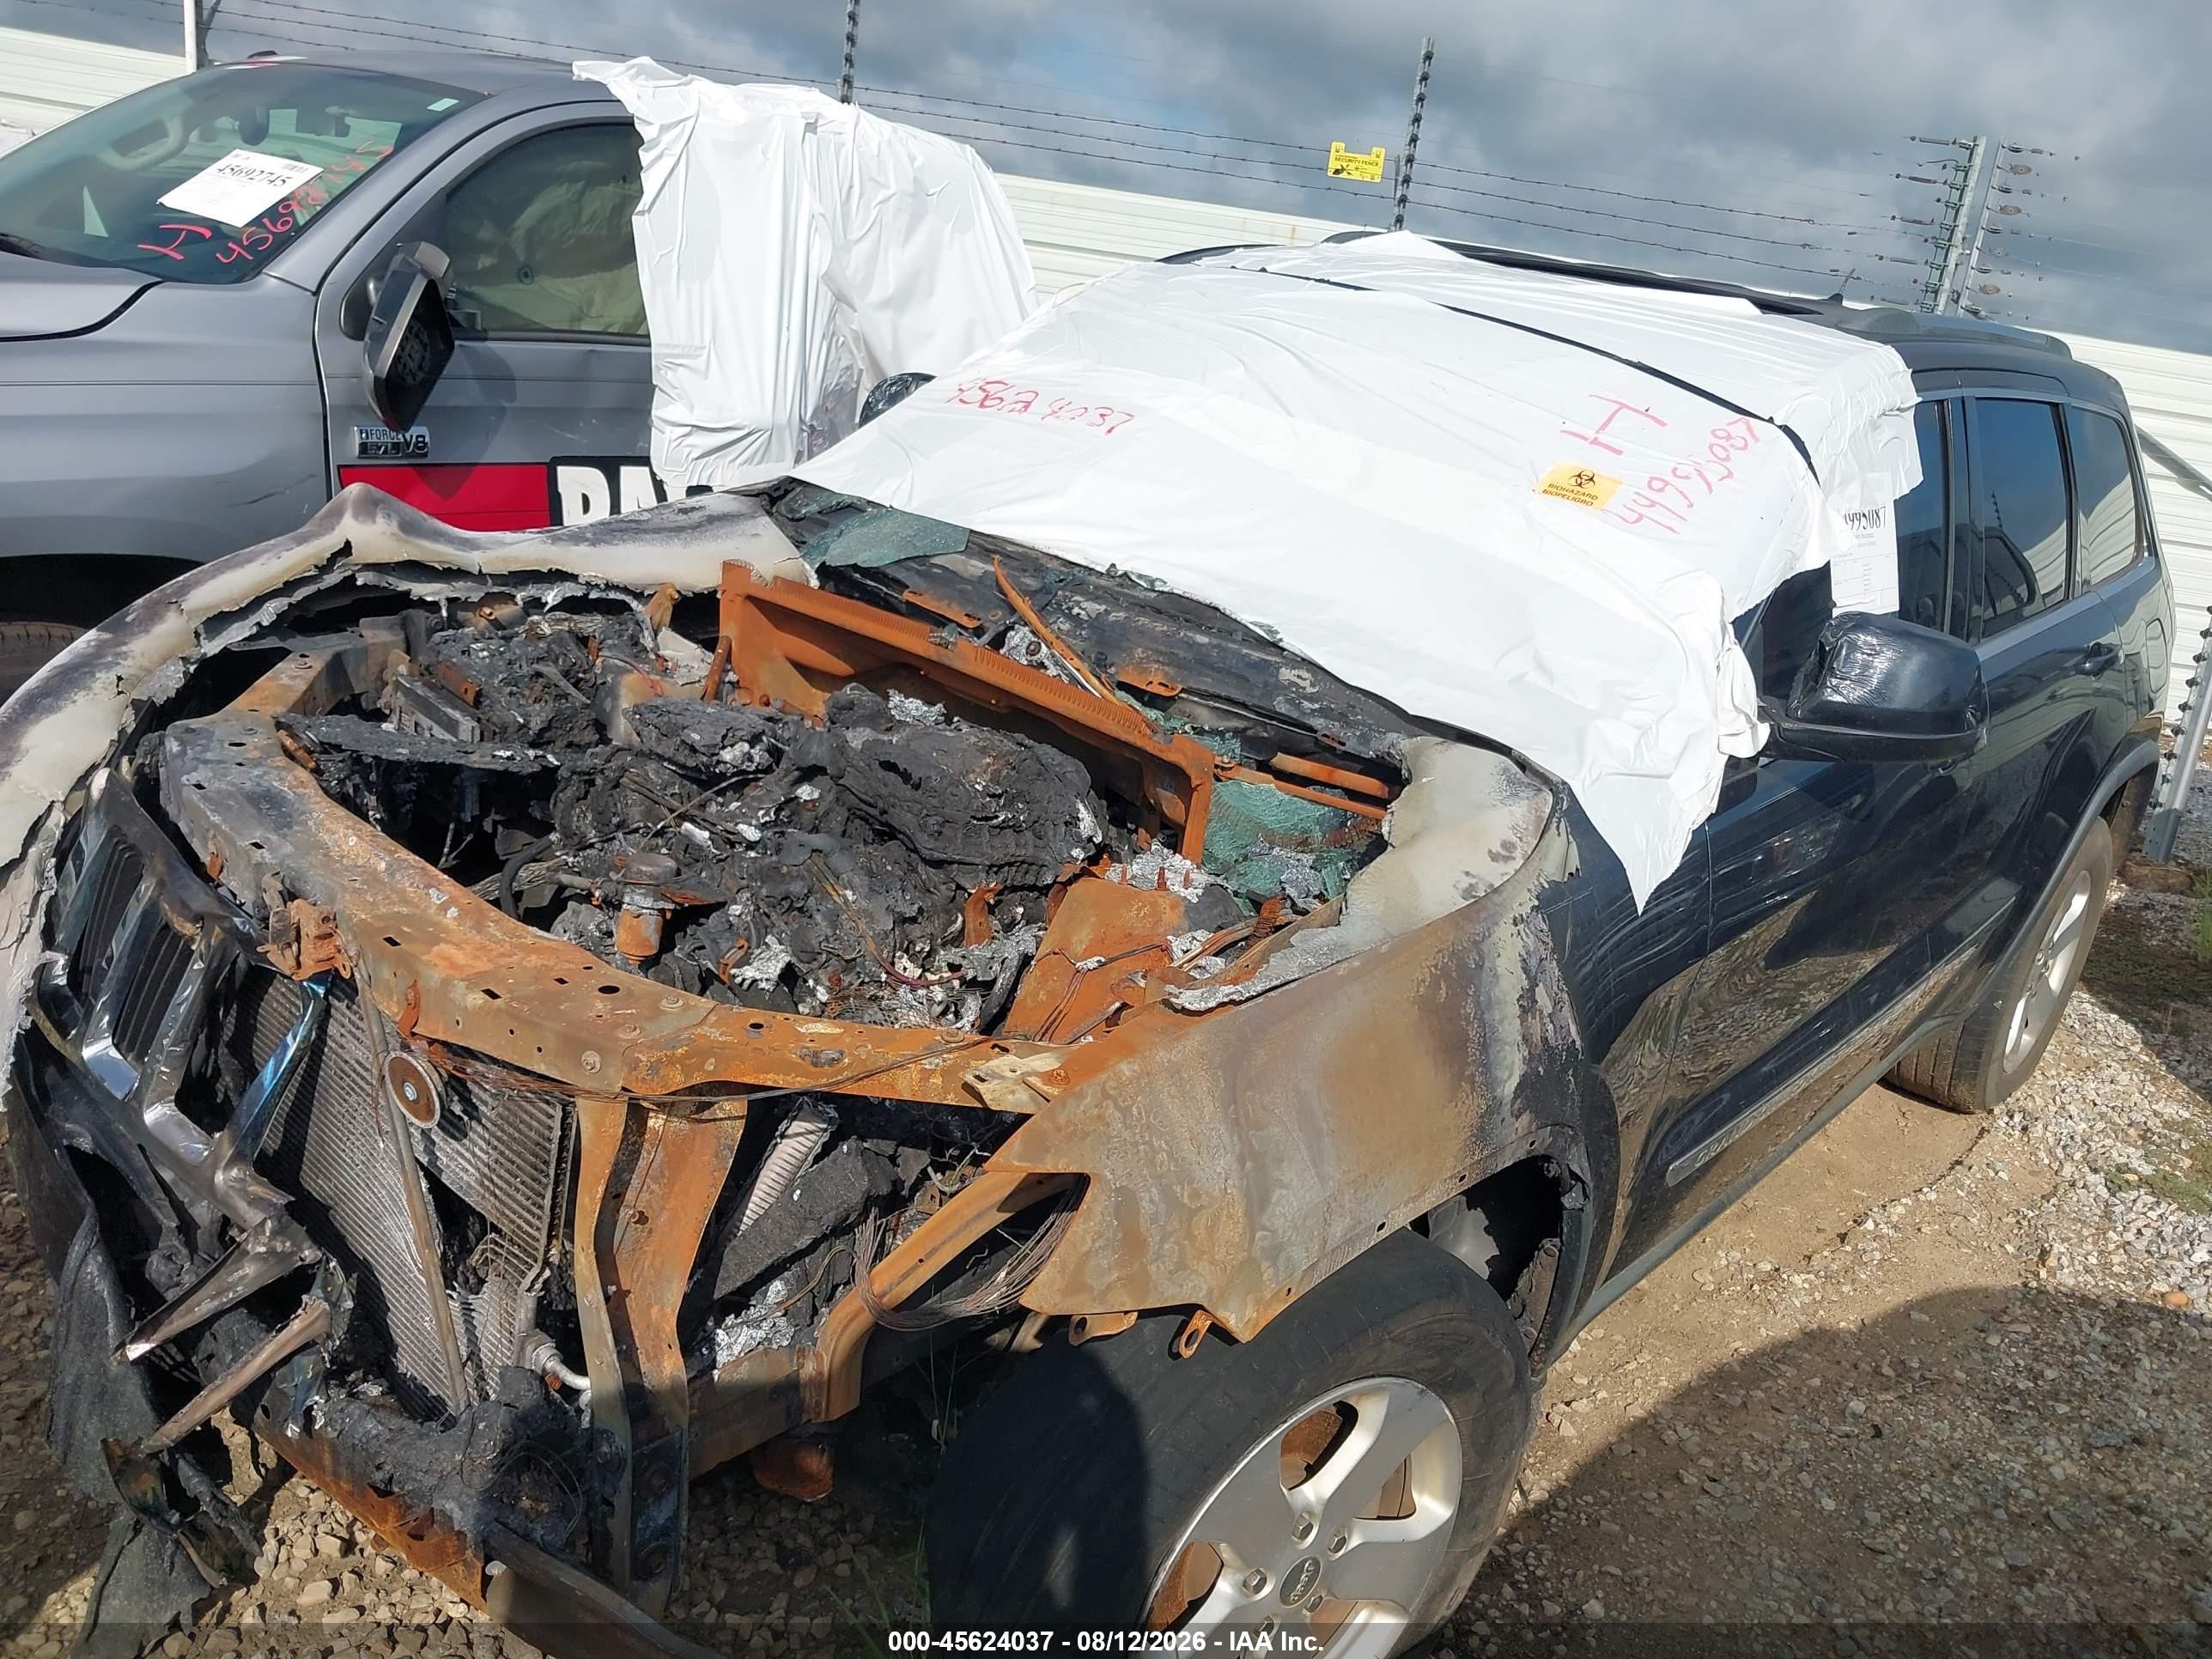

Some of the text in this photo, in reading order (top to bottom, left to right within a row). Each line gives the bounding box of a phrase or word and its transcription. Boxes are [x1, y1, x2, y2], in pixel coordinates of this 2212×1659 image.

[1334, 156, 1361, 165] SECURITY
[216, 163, 294, 187] 45692745
[402, 434, 428, 453] V8
[1541, 489, 1594, 507] BIOPELIGRO
[1547, 483, 1599, 501] BIOHAZARD
